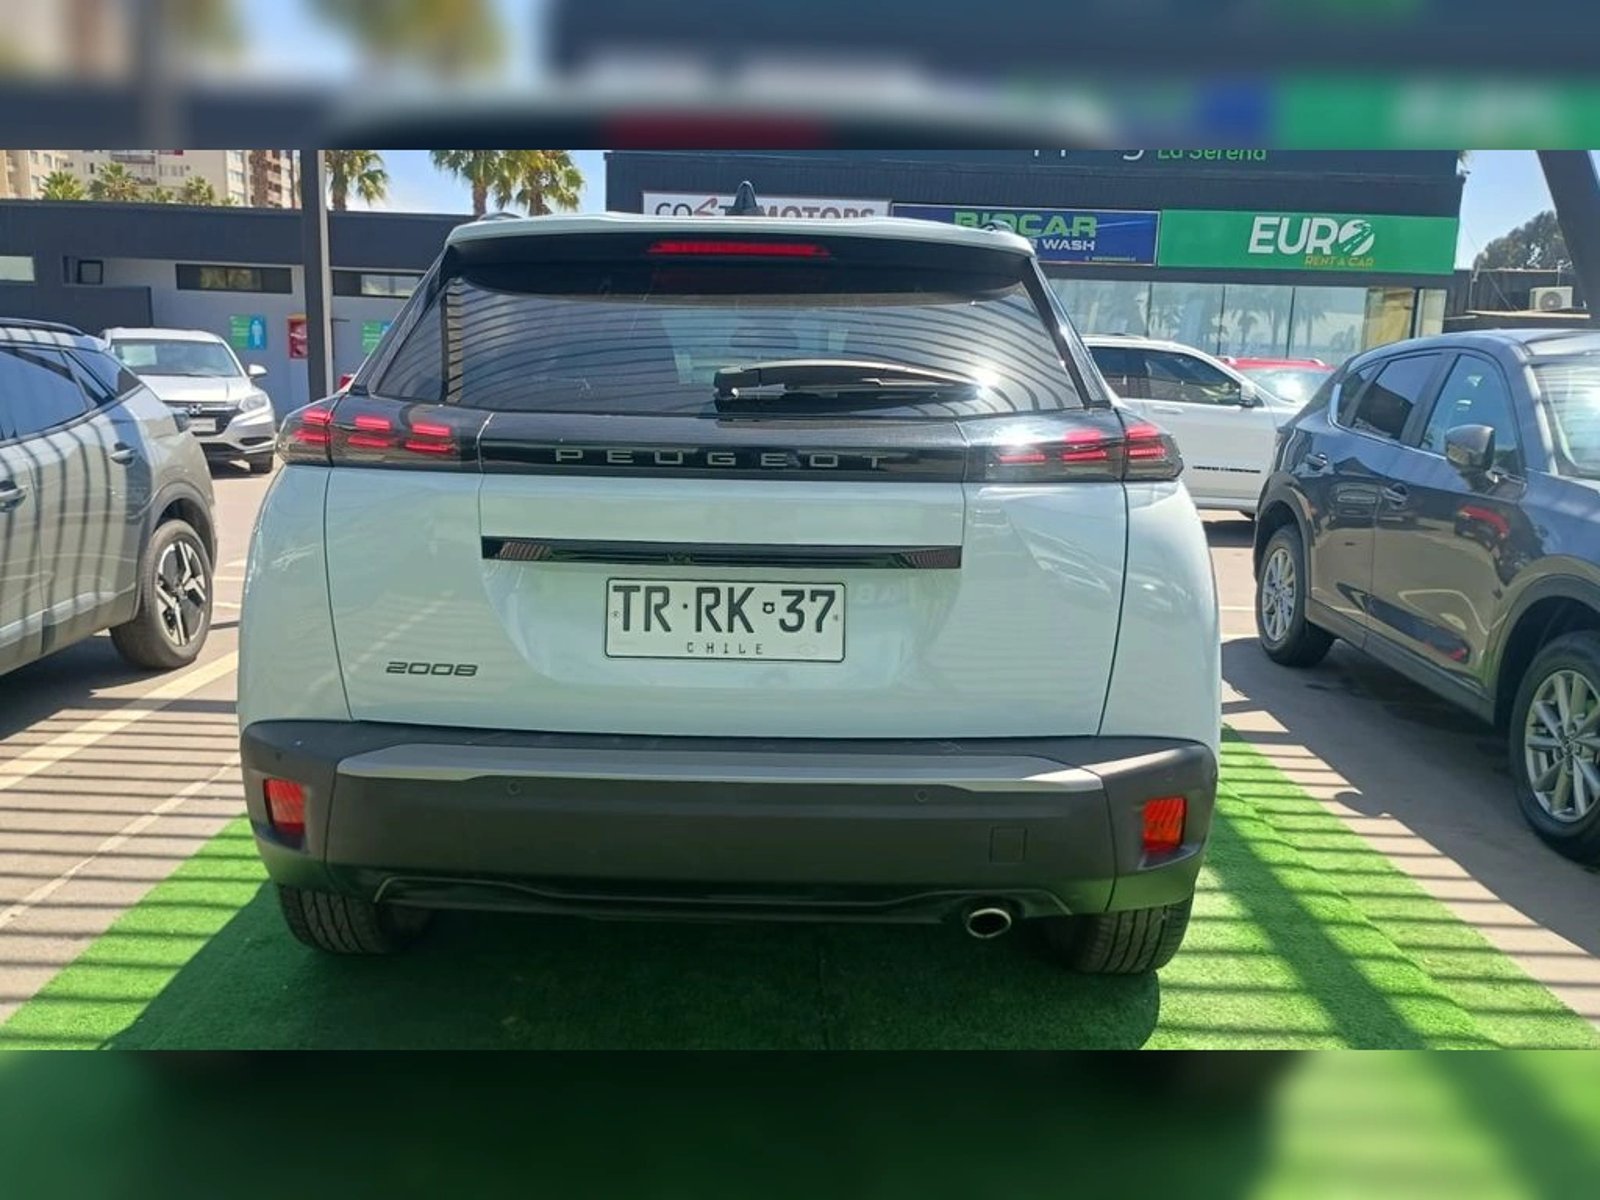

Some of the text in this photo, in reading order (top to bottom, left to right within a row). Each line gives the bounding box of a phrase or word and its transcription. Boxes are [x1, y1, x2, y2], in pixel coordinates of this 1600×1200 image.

[1041, 238, 1096, 251] WASH
[555, 448, 888, 469] PEUGEOT
[686, 642, 763, 655] CHILE
[386, 661, 478, 677] 2008
